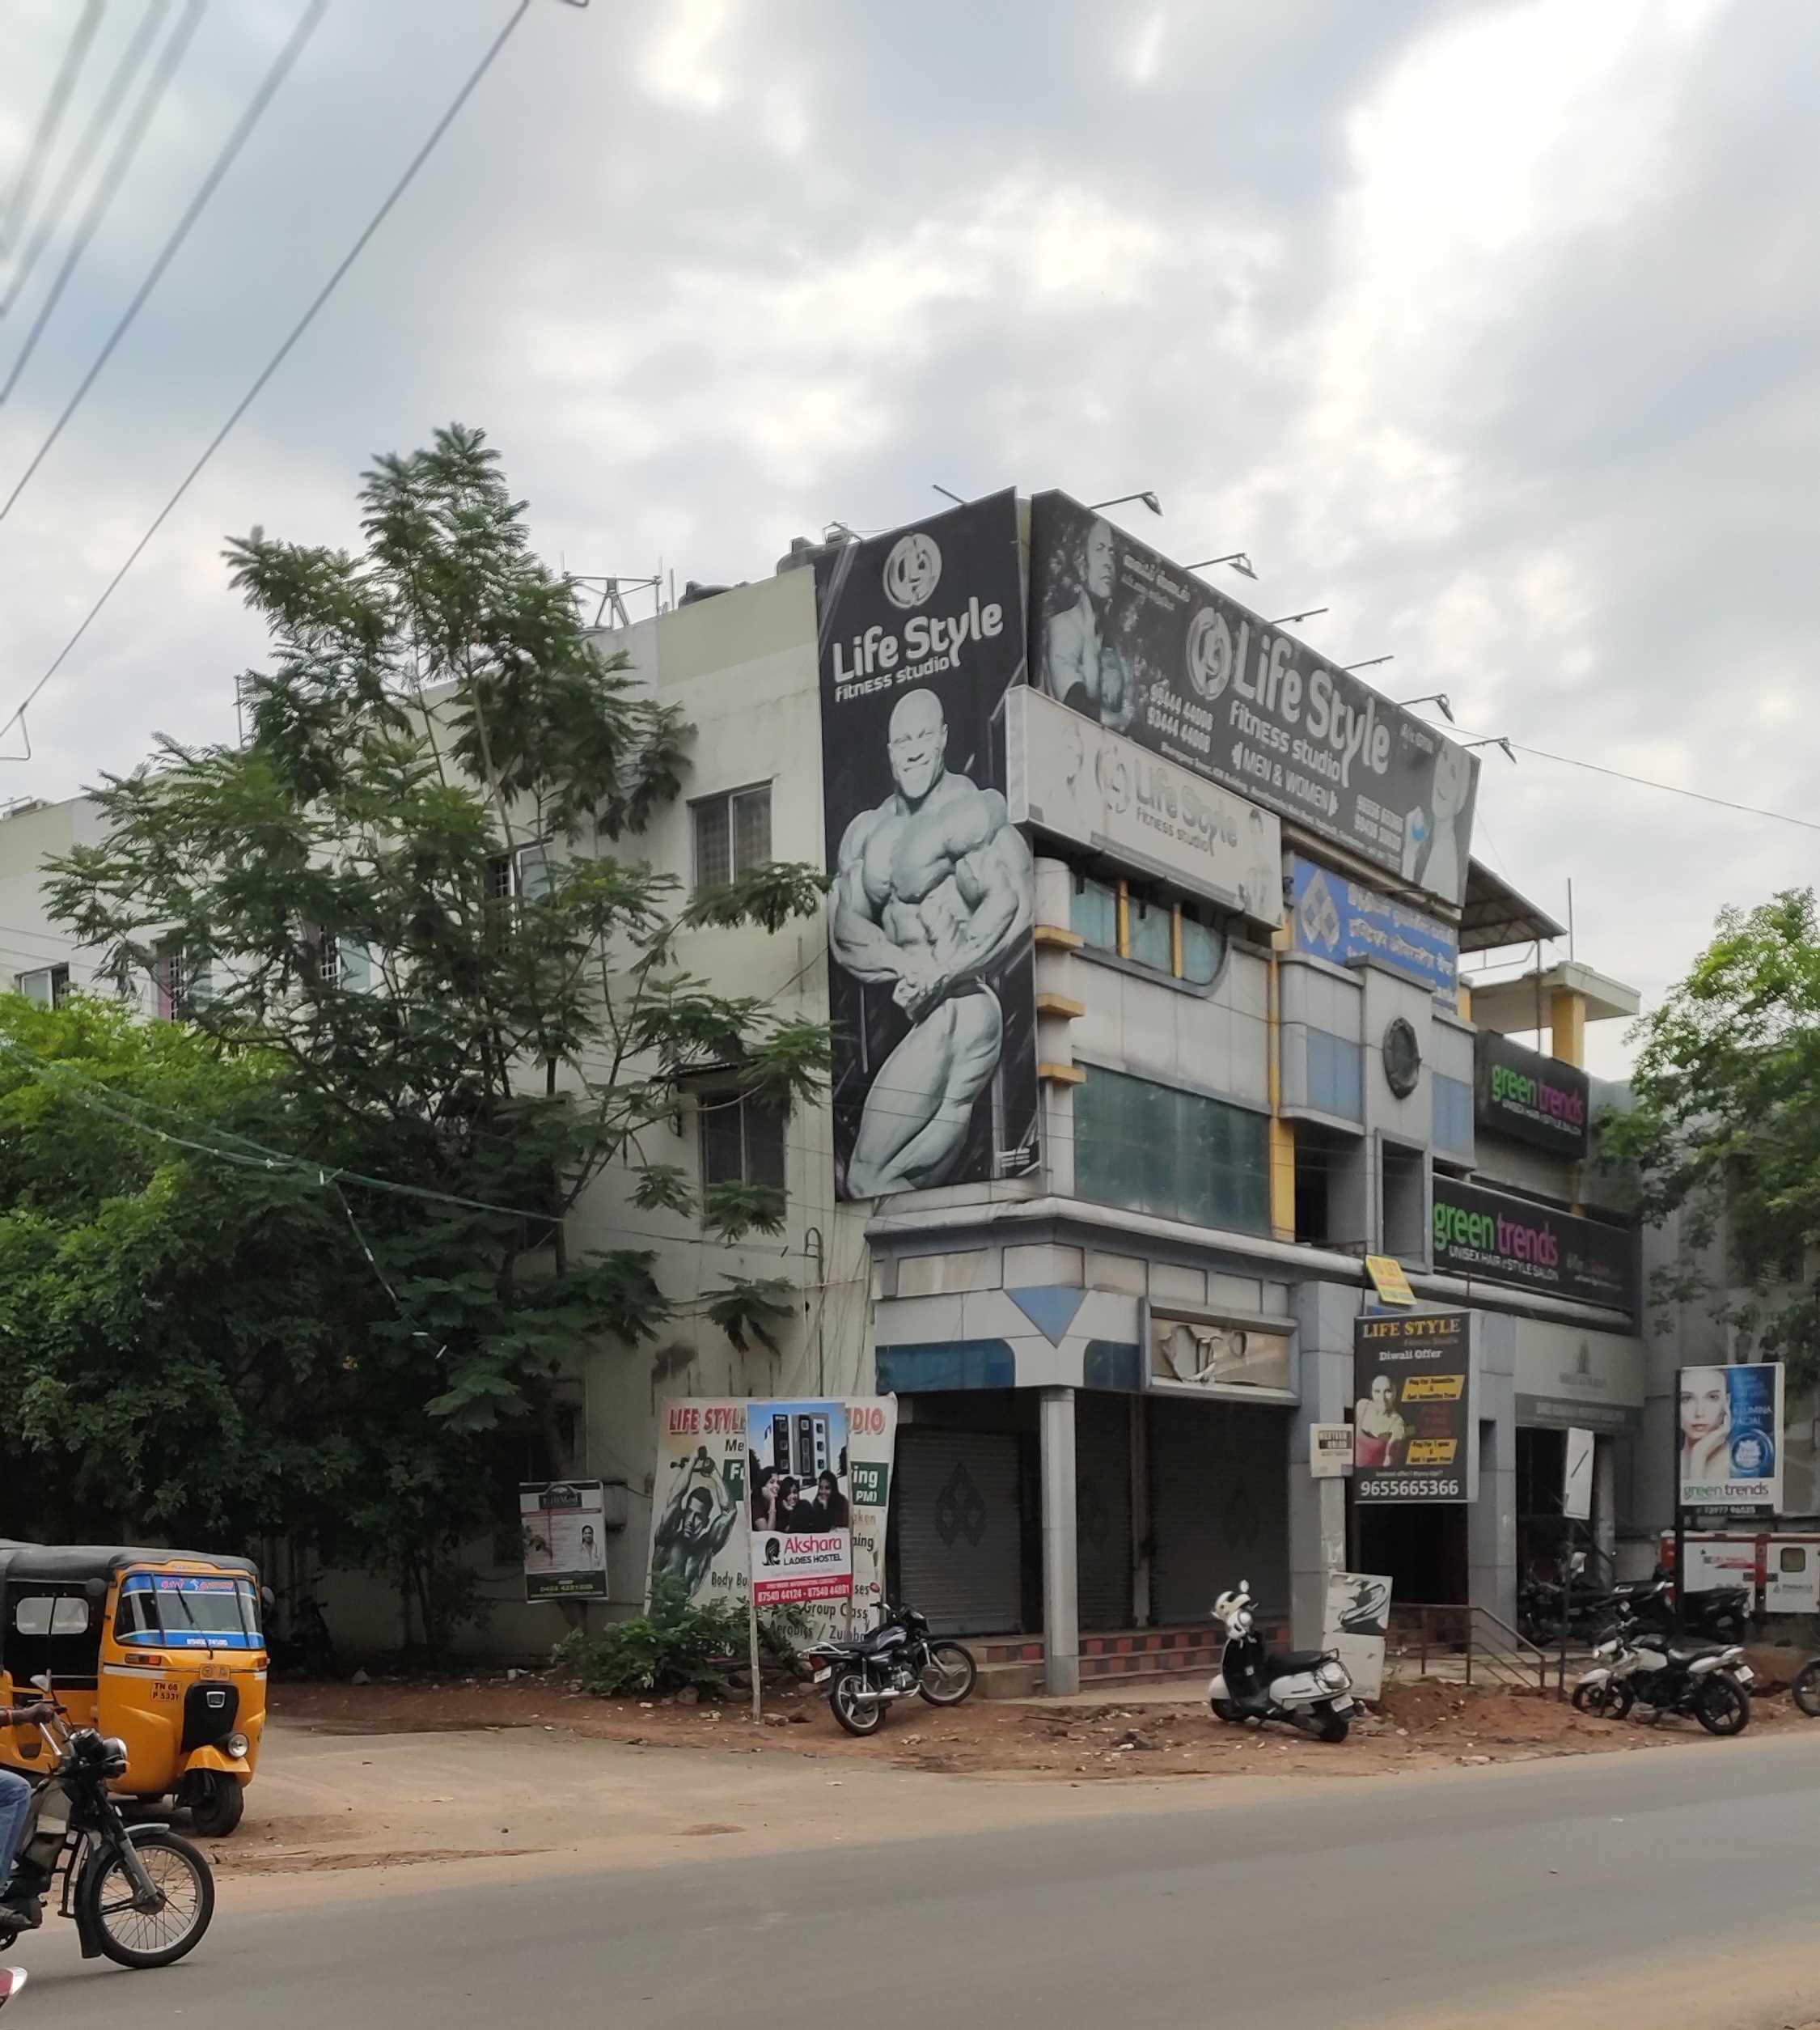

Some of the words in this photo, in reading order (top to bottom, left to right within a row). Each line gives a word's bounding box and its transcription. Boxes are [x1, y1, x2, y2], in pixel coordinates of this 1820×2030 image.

[833, 625, 899, 683] Life
[904, 596, 1003, 667] Style
[1234, 621, 1302, 723] Life
[1306, 669, 1390, 788] Style
[1491, 1065, 1538, 1108] green
[1539, 1078, 1584, 1126] trends
[1433, 1202, 1495, 1252] green
[1496, 1211, 1560, 1268] trends
[1363, 1322, 1400, 1338] LIFE
[1404, 1318, 1461, 1336] STYLE
[1379, 1350, 1412, 1361] Diwali
[1414, 1348, 1443, 1359] Offer
[669, 1407, 700, 1435] LIFE
[1361, 1479, 1459, 1496] 9655665366
[1683, 1482, 1723, 1501] green
[1725, 1481, 1769, 1496] trends
[784, 1535, 843, 1554] Akshara
[783, 1555, 812, 1566] LADIES
[813, 1553, 843, 1564] HOSTEL
[712, 1570, 734, 1591] Body
